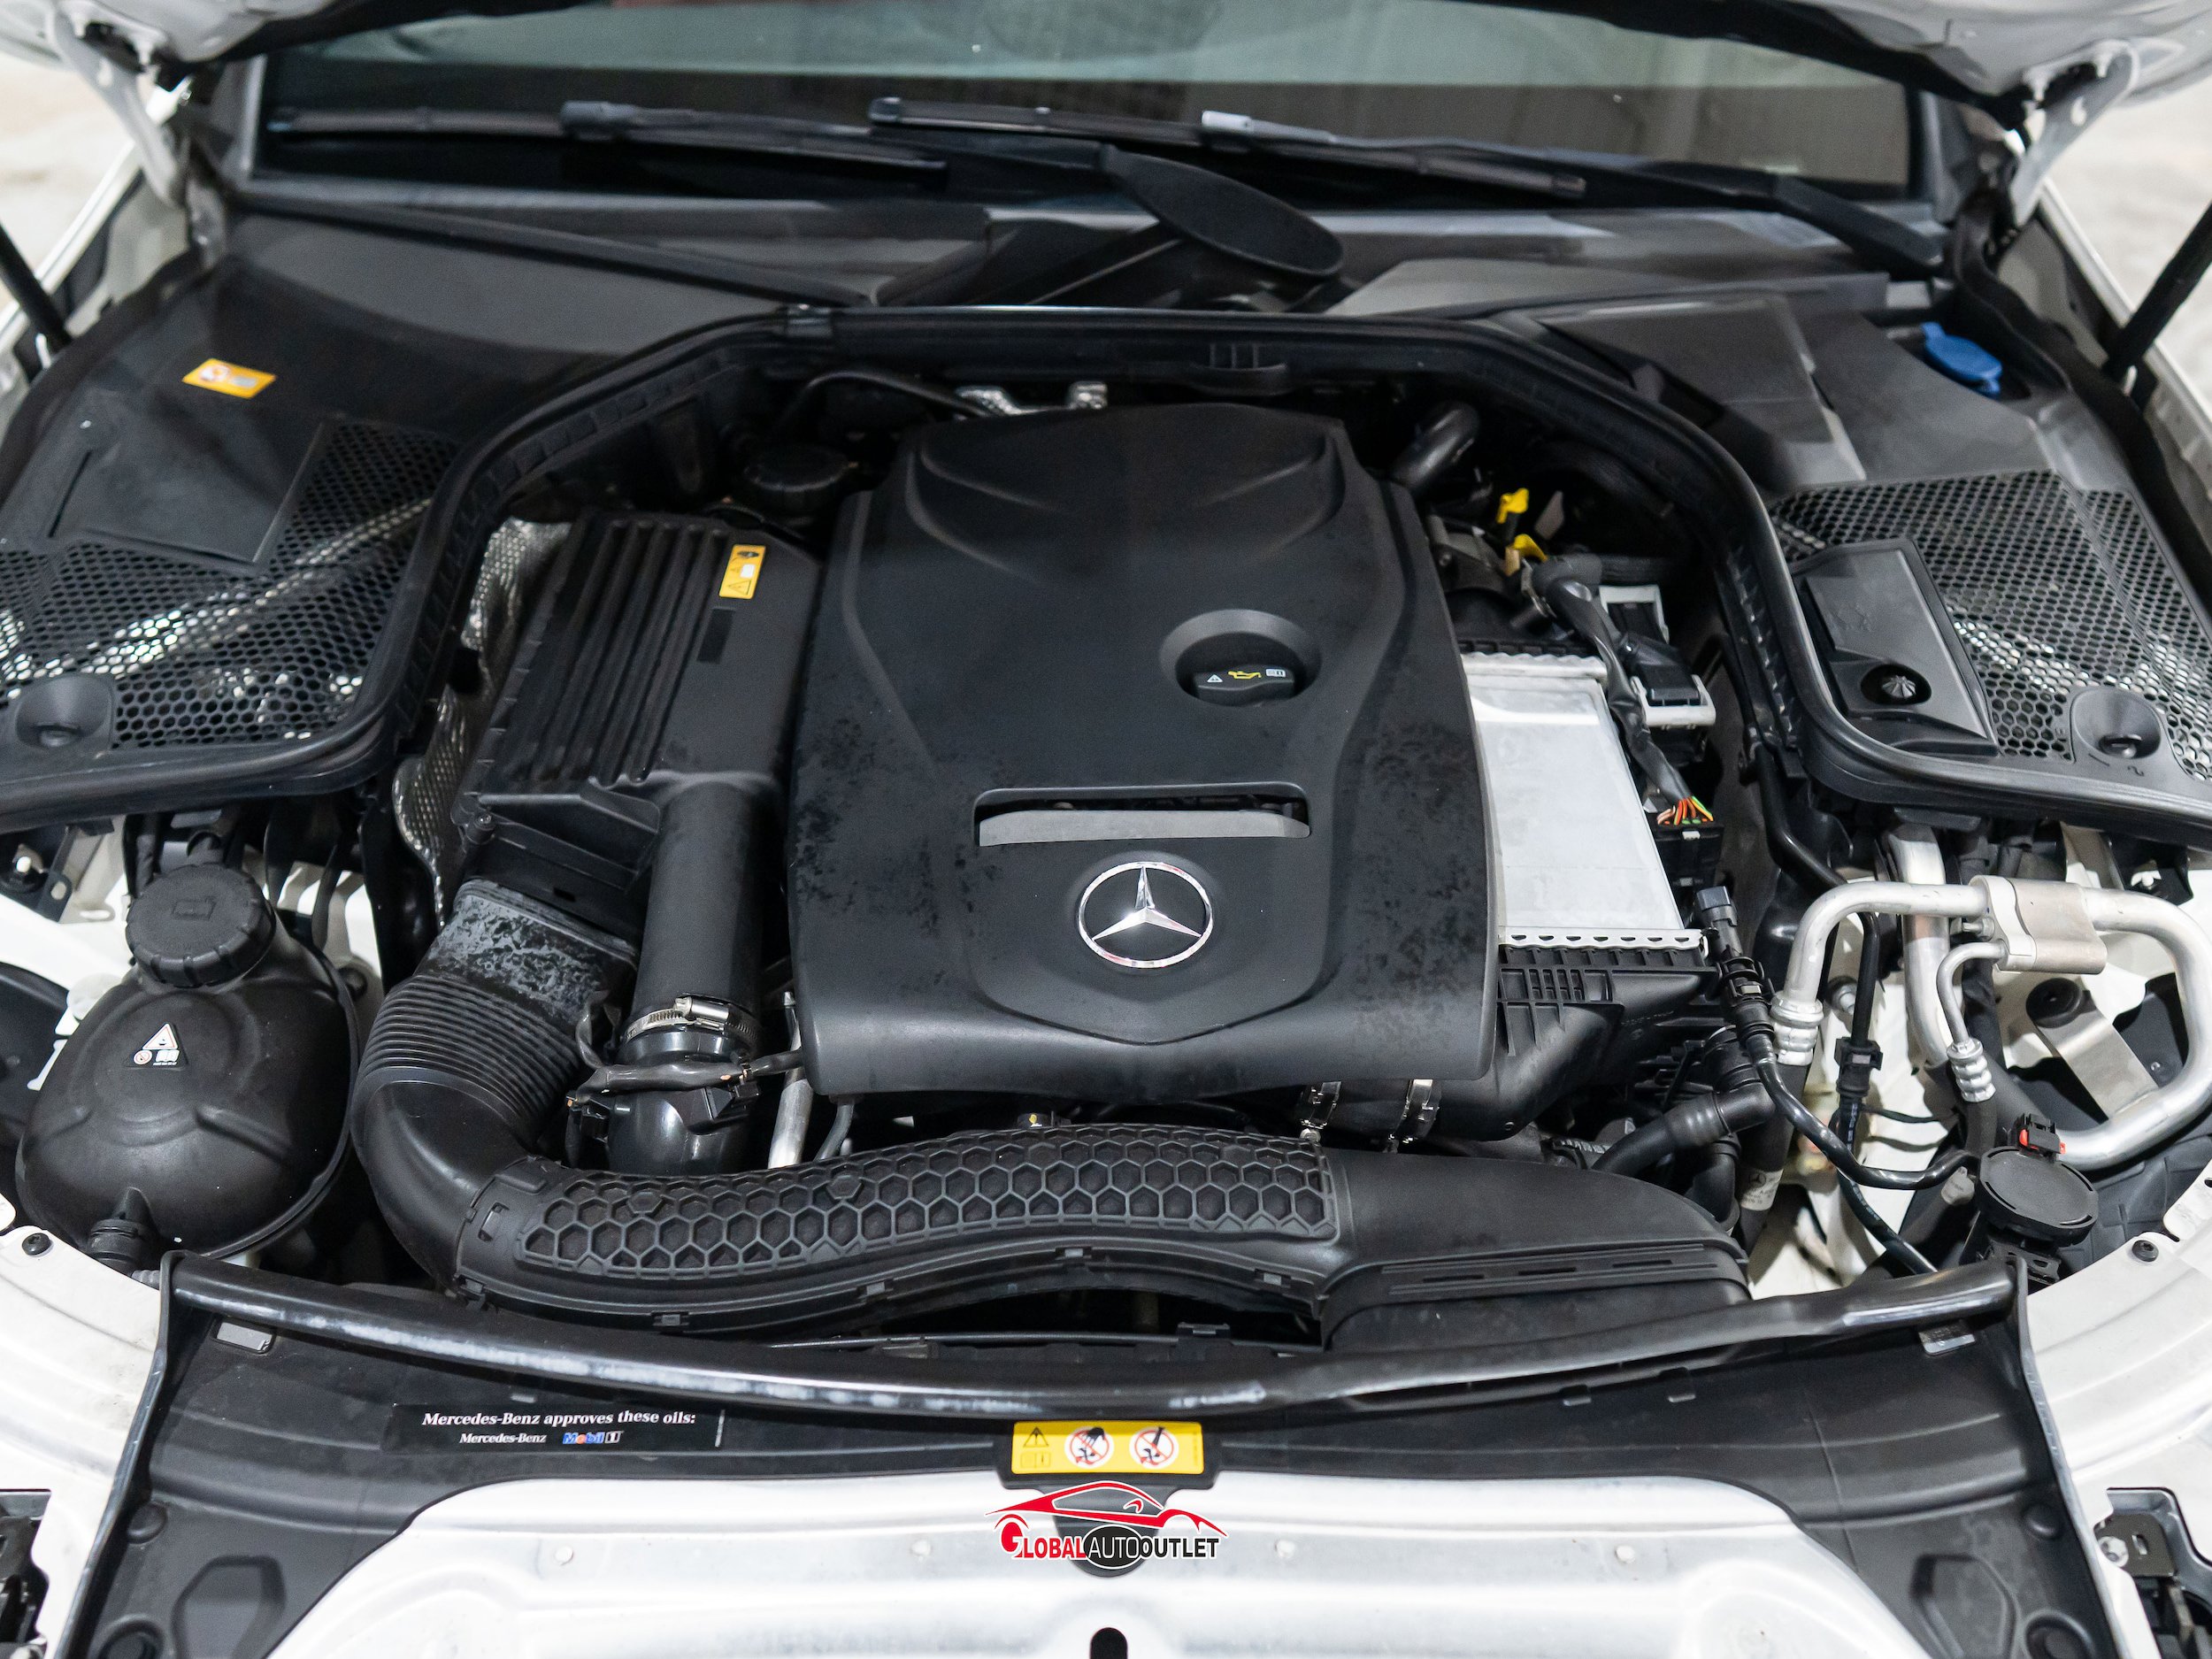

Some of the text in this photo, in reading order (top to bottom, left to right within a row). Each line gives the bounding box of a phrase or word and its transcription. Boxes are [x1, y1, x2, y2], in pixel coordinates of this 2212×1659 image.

[422, 1409, 696, 1427] Mercedes-Benz approves these oils:
[459, 1432, 547, 1444] Mercedes-Benz
[563, 1432, 604, 1444] Mobil
